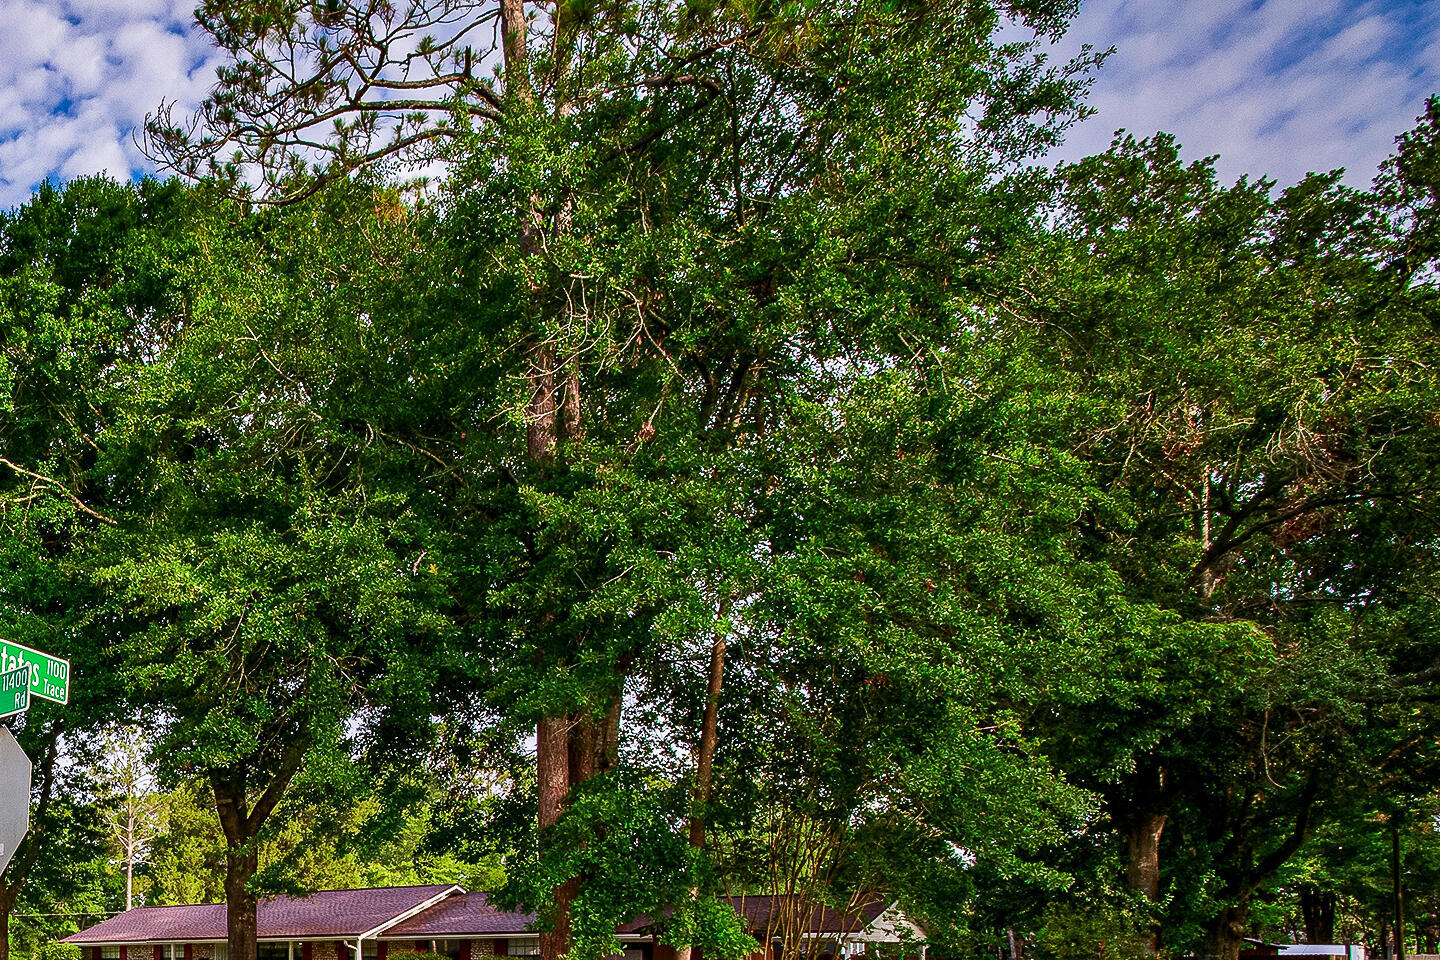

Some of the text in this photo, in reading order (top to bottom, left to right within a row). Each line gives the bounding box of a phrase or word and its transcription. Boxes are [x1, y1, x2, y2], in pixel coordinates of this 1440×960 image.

[2, 668, 28, 692] 11400
[46, 659, 67, 681] 1100
[14, 690, 26, 709] Rd
[43, 678, 65, 700] Trace
